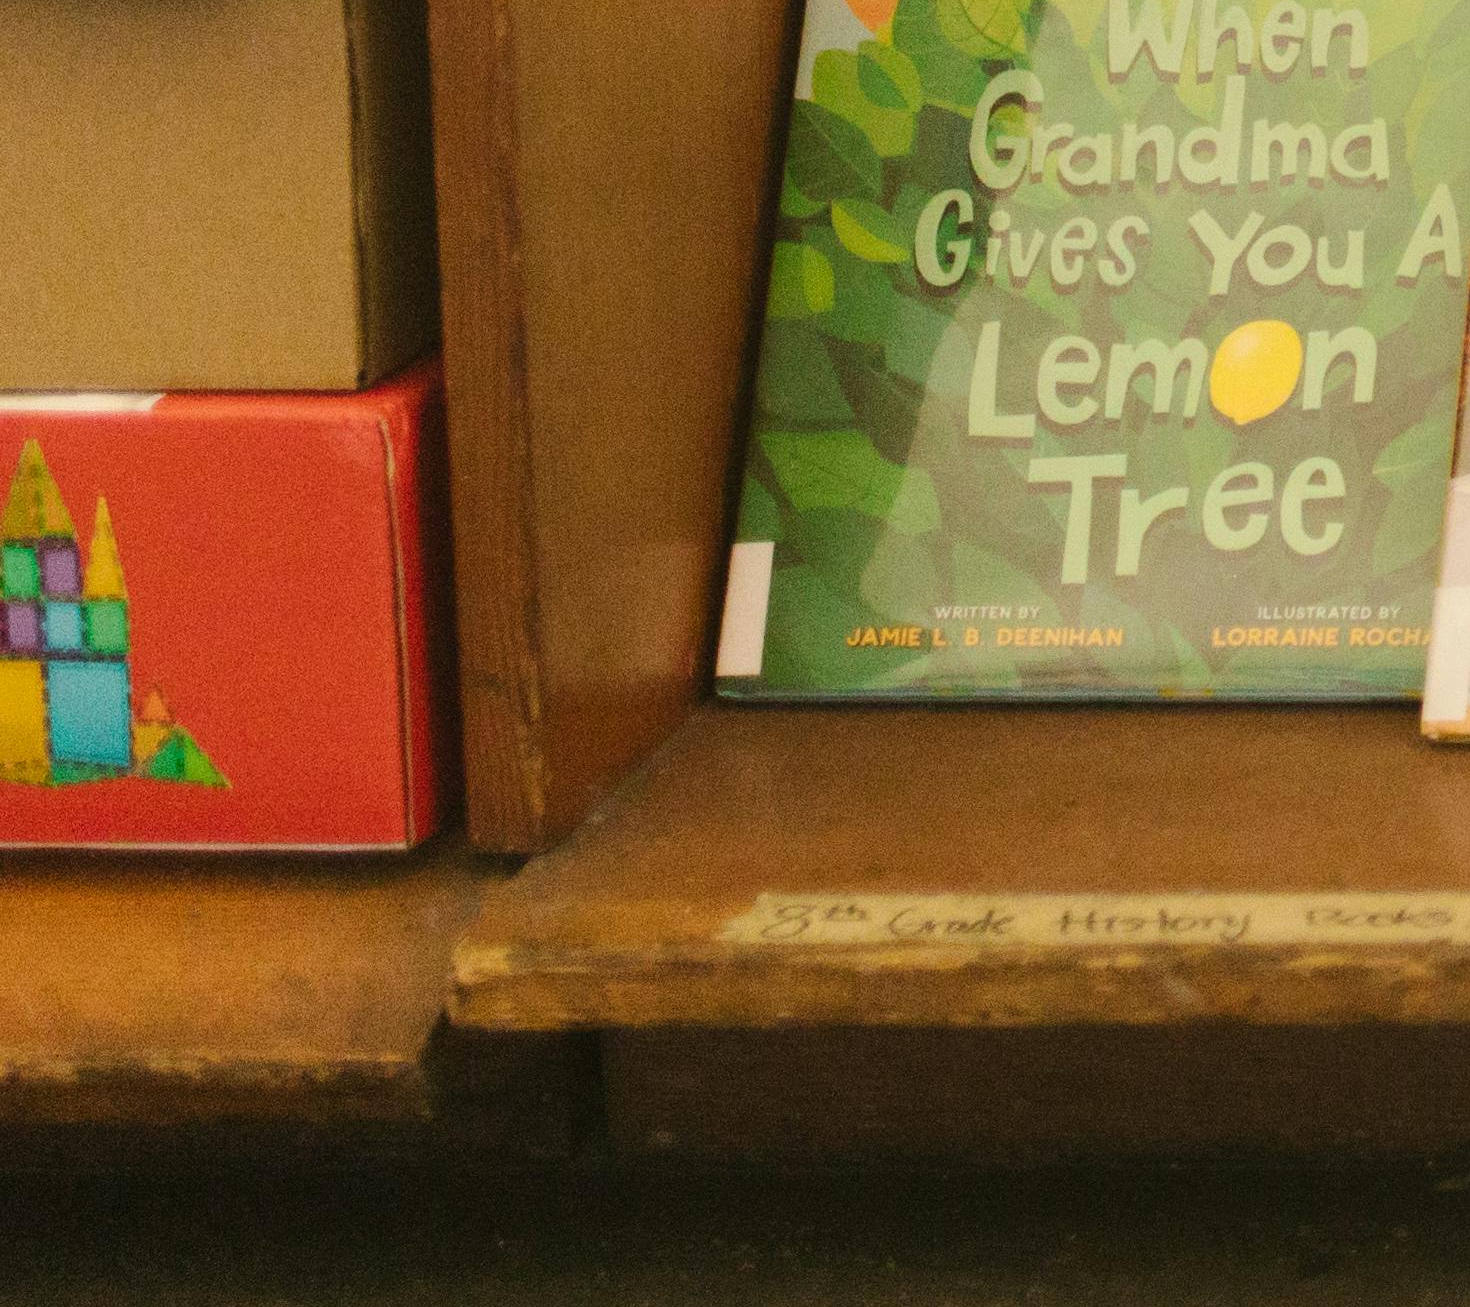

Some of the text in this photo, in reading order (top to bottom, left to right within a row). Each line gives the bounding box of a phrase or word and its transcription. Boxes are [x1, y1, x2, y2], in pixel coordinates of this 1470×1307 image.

[968, 69, 1393, 189] Grandma
[912, 186, 1464, 297] Gives You A
[1027, 453, 1348, 586] Tree
[934, 603, 1042, 621] WRITTEN BY
[1256, 604, 1401, 620] ILLUSTRATED BY
[846, 624, 1125, 650] JAMIE L. B. DEENIHAN
[1211, 626, 1341, 649] LORRAINE
[759, 901, 1458, 945] 8th Grade History Books
